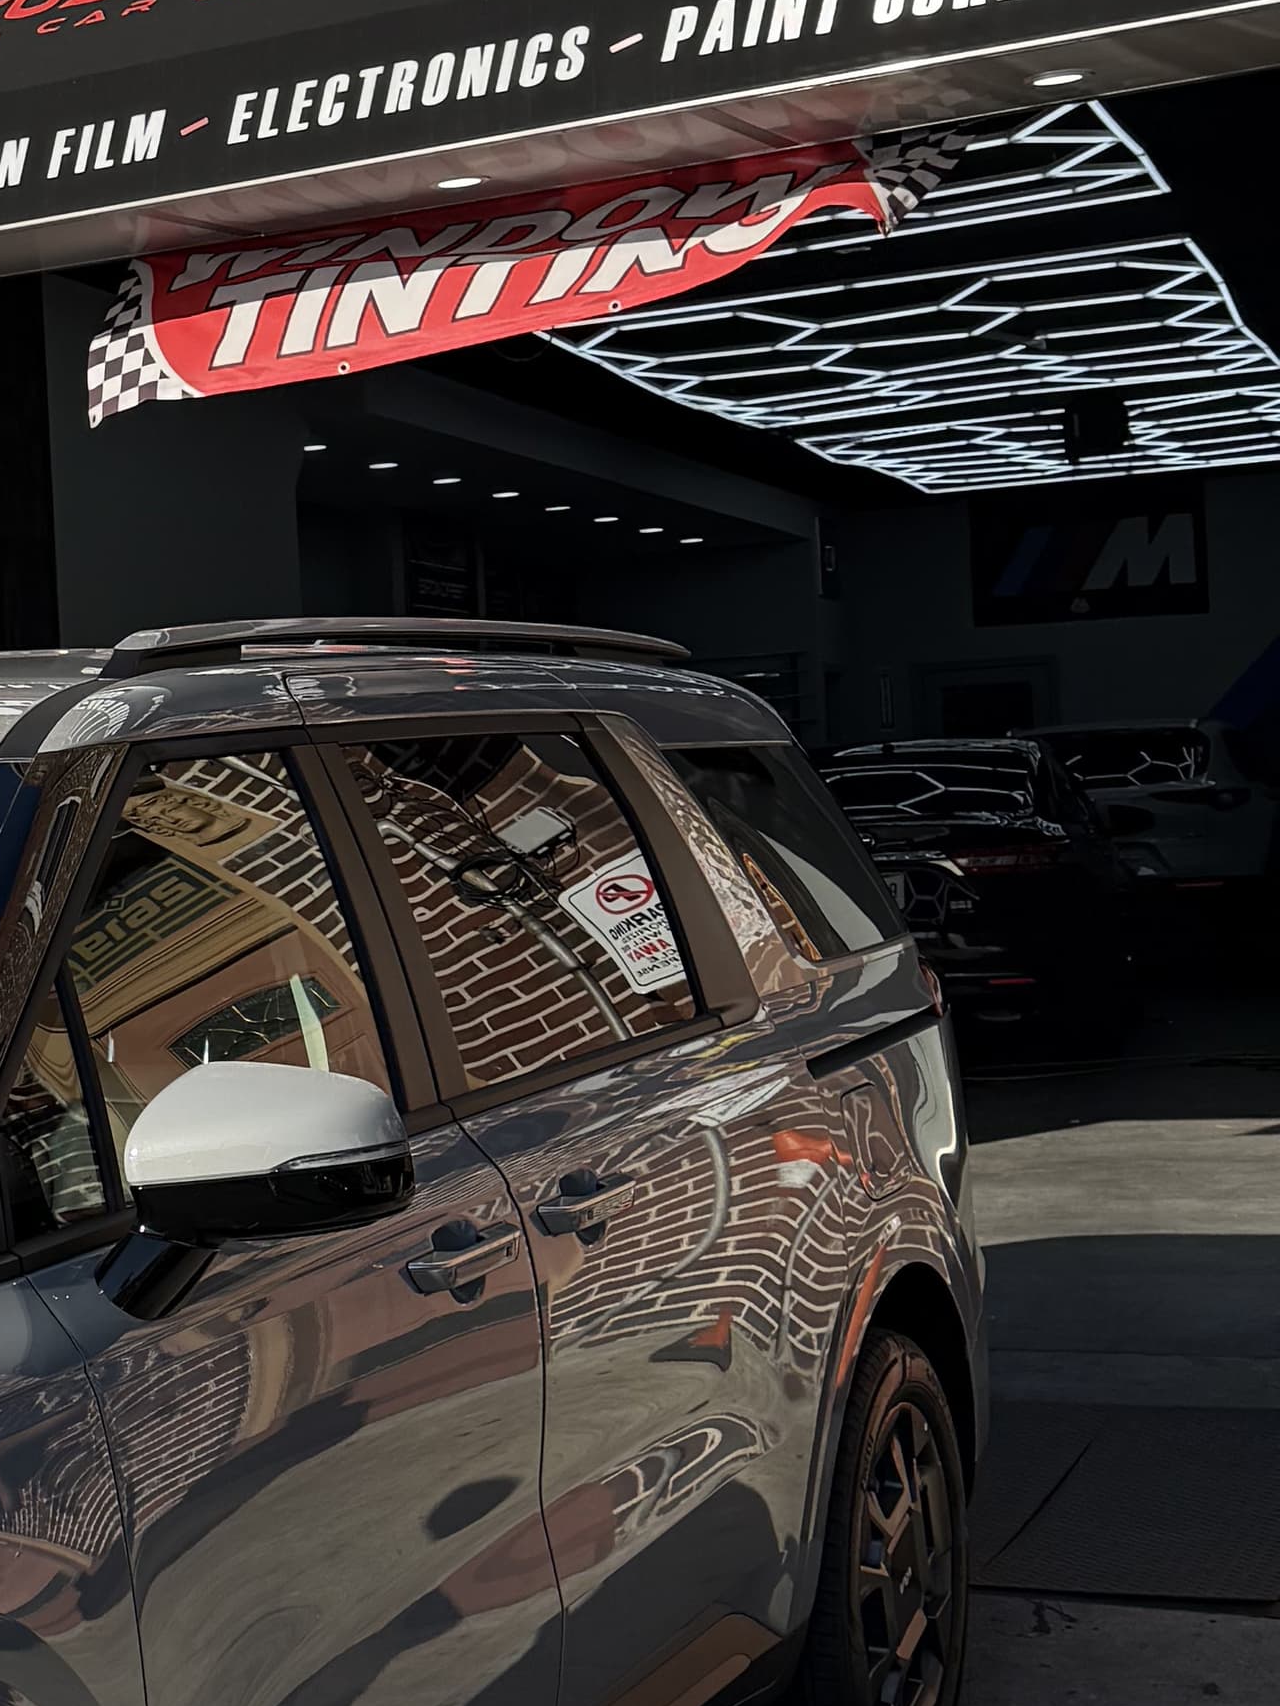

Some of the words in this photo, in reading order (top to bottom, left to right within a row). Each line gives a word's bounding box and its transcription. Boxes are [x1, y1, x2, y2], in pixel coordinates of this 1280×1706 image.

[47, 109, 167, 179] FILM
[226, 25, 591, 146] ELECTRONICS
[171, 161, 845, 288] WINDOW
[208, 188, 815, 371] TINTING
